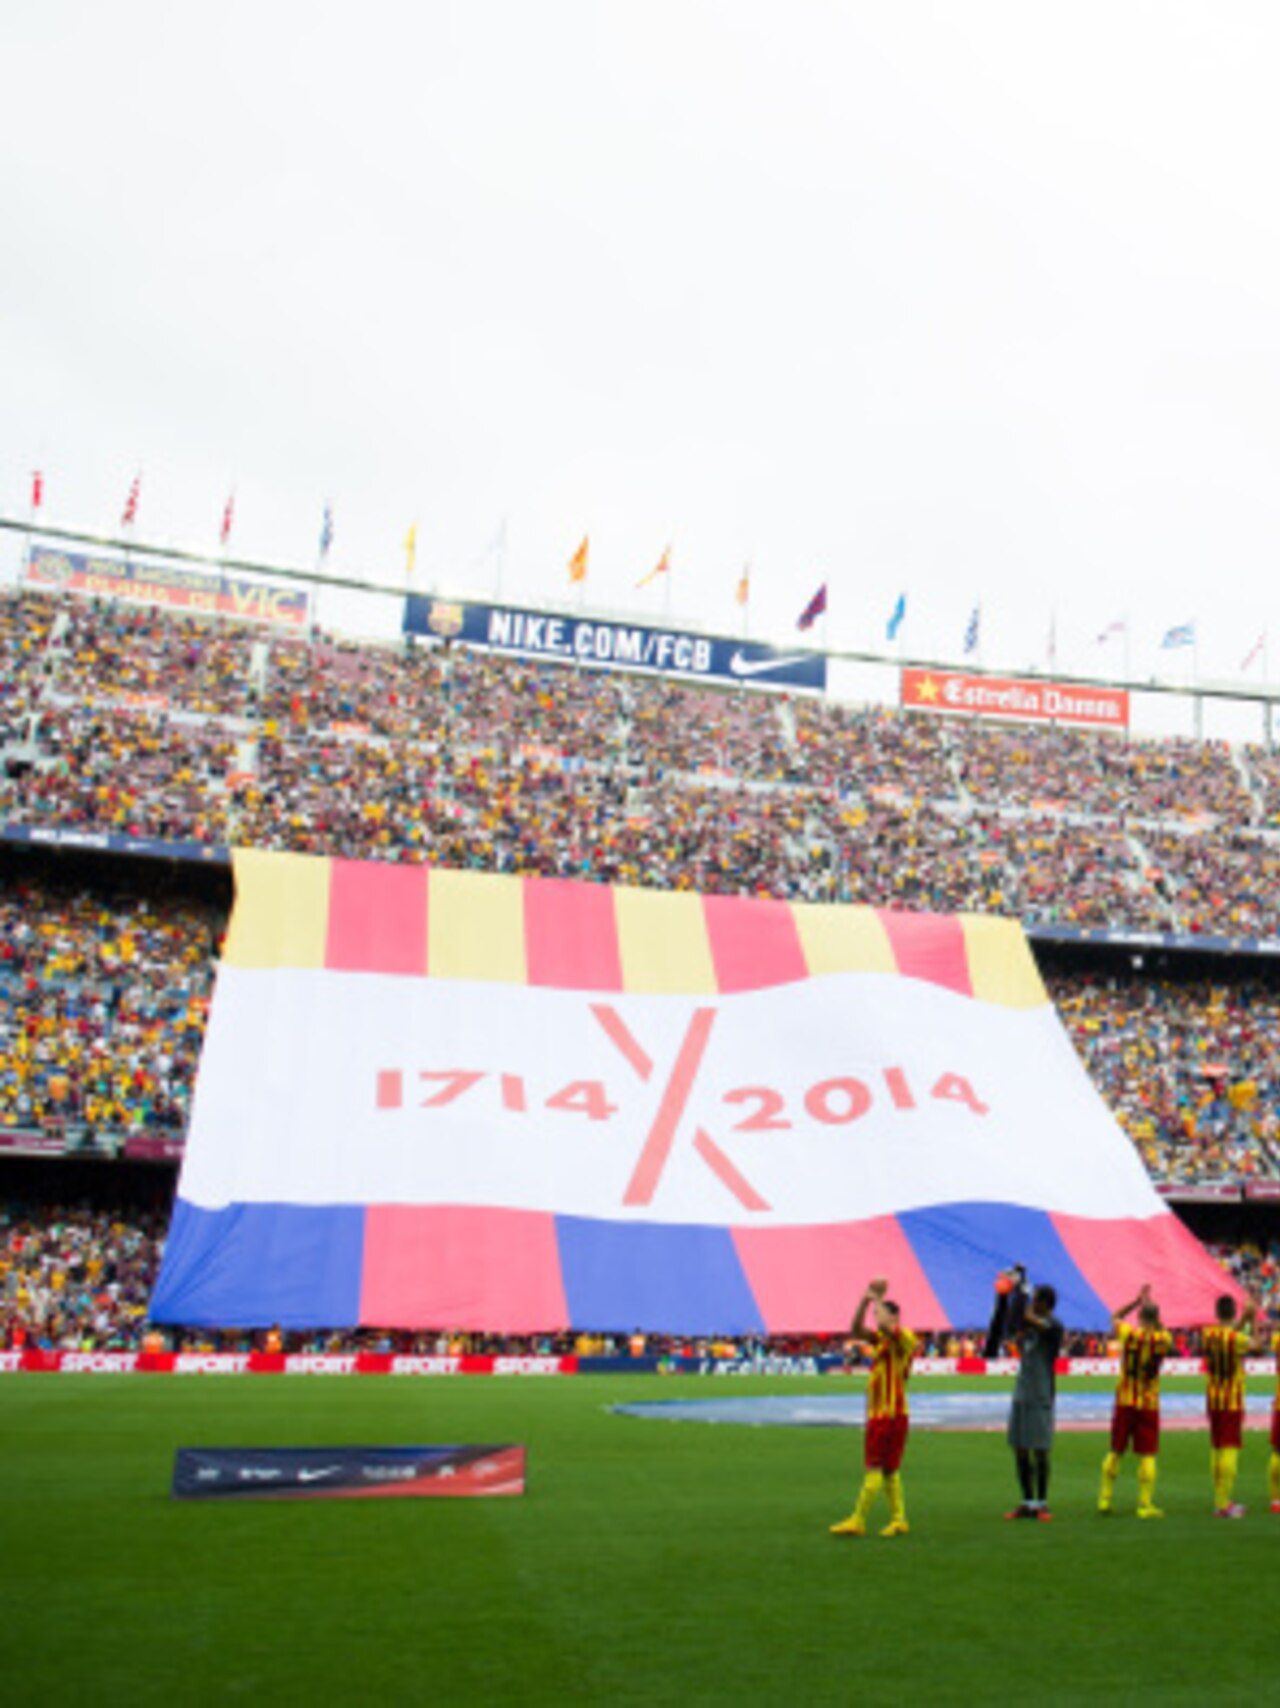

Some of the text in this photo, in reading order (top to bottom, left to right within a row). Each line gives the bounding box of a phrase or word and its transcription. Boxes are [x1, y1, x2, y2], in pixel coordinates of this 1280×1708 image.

[229, 581, 296, 621] VIC
[488, 609, 712, 672] NIKE.COM/FCB
[943, 678, 1120, 719] Estrella Damm
[376, 1069, 618, 1121] 1714
[721, 1066, 990, 1132] 2014
[60, 1353, 139, 1372] SPORT
[174, 1353, 250, 1373] SPORT
[285, 1354, 363, 1374] SPORT
[391, 1355, 461, 1374] SPORT
[494, 1355, 562, 1374] SPORT
